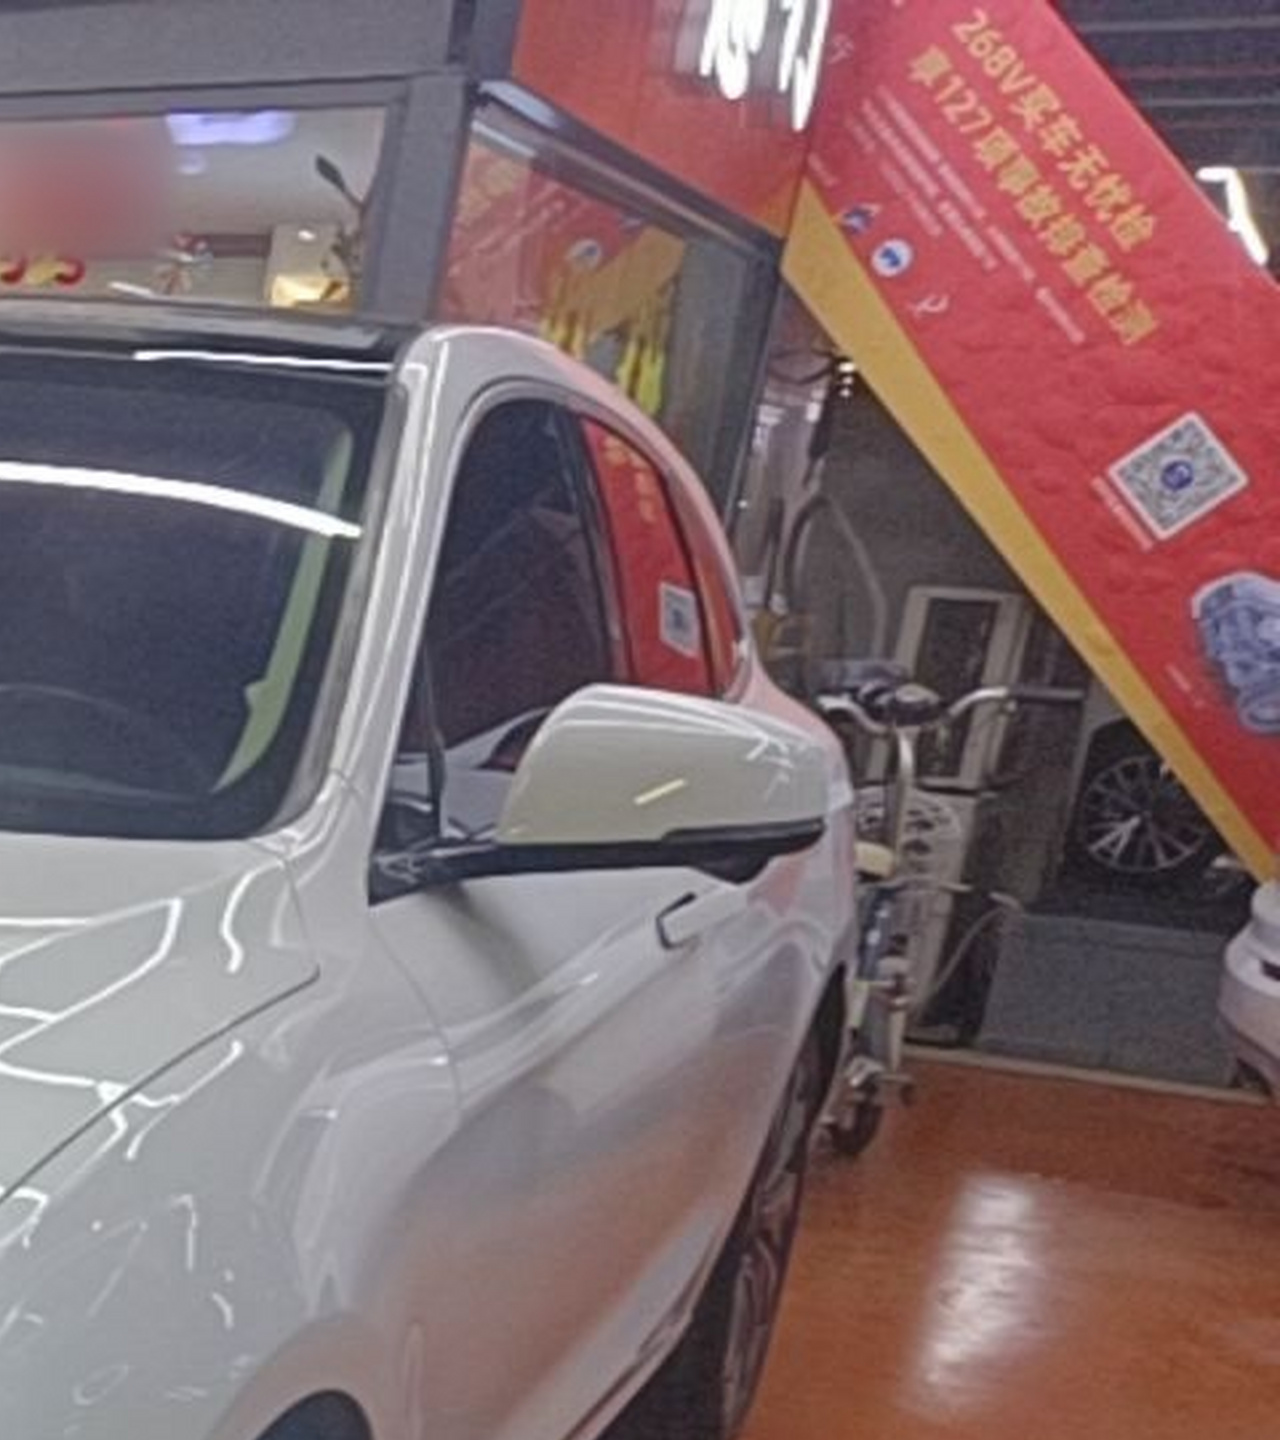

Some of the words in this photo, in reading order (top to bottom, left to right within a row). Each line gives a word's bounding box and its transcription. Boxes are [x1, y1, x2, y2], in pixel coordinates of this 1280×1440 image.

[950, 6, 1157, 255] 268V买车无忧检
